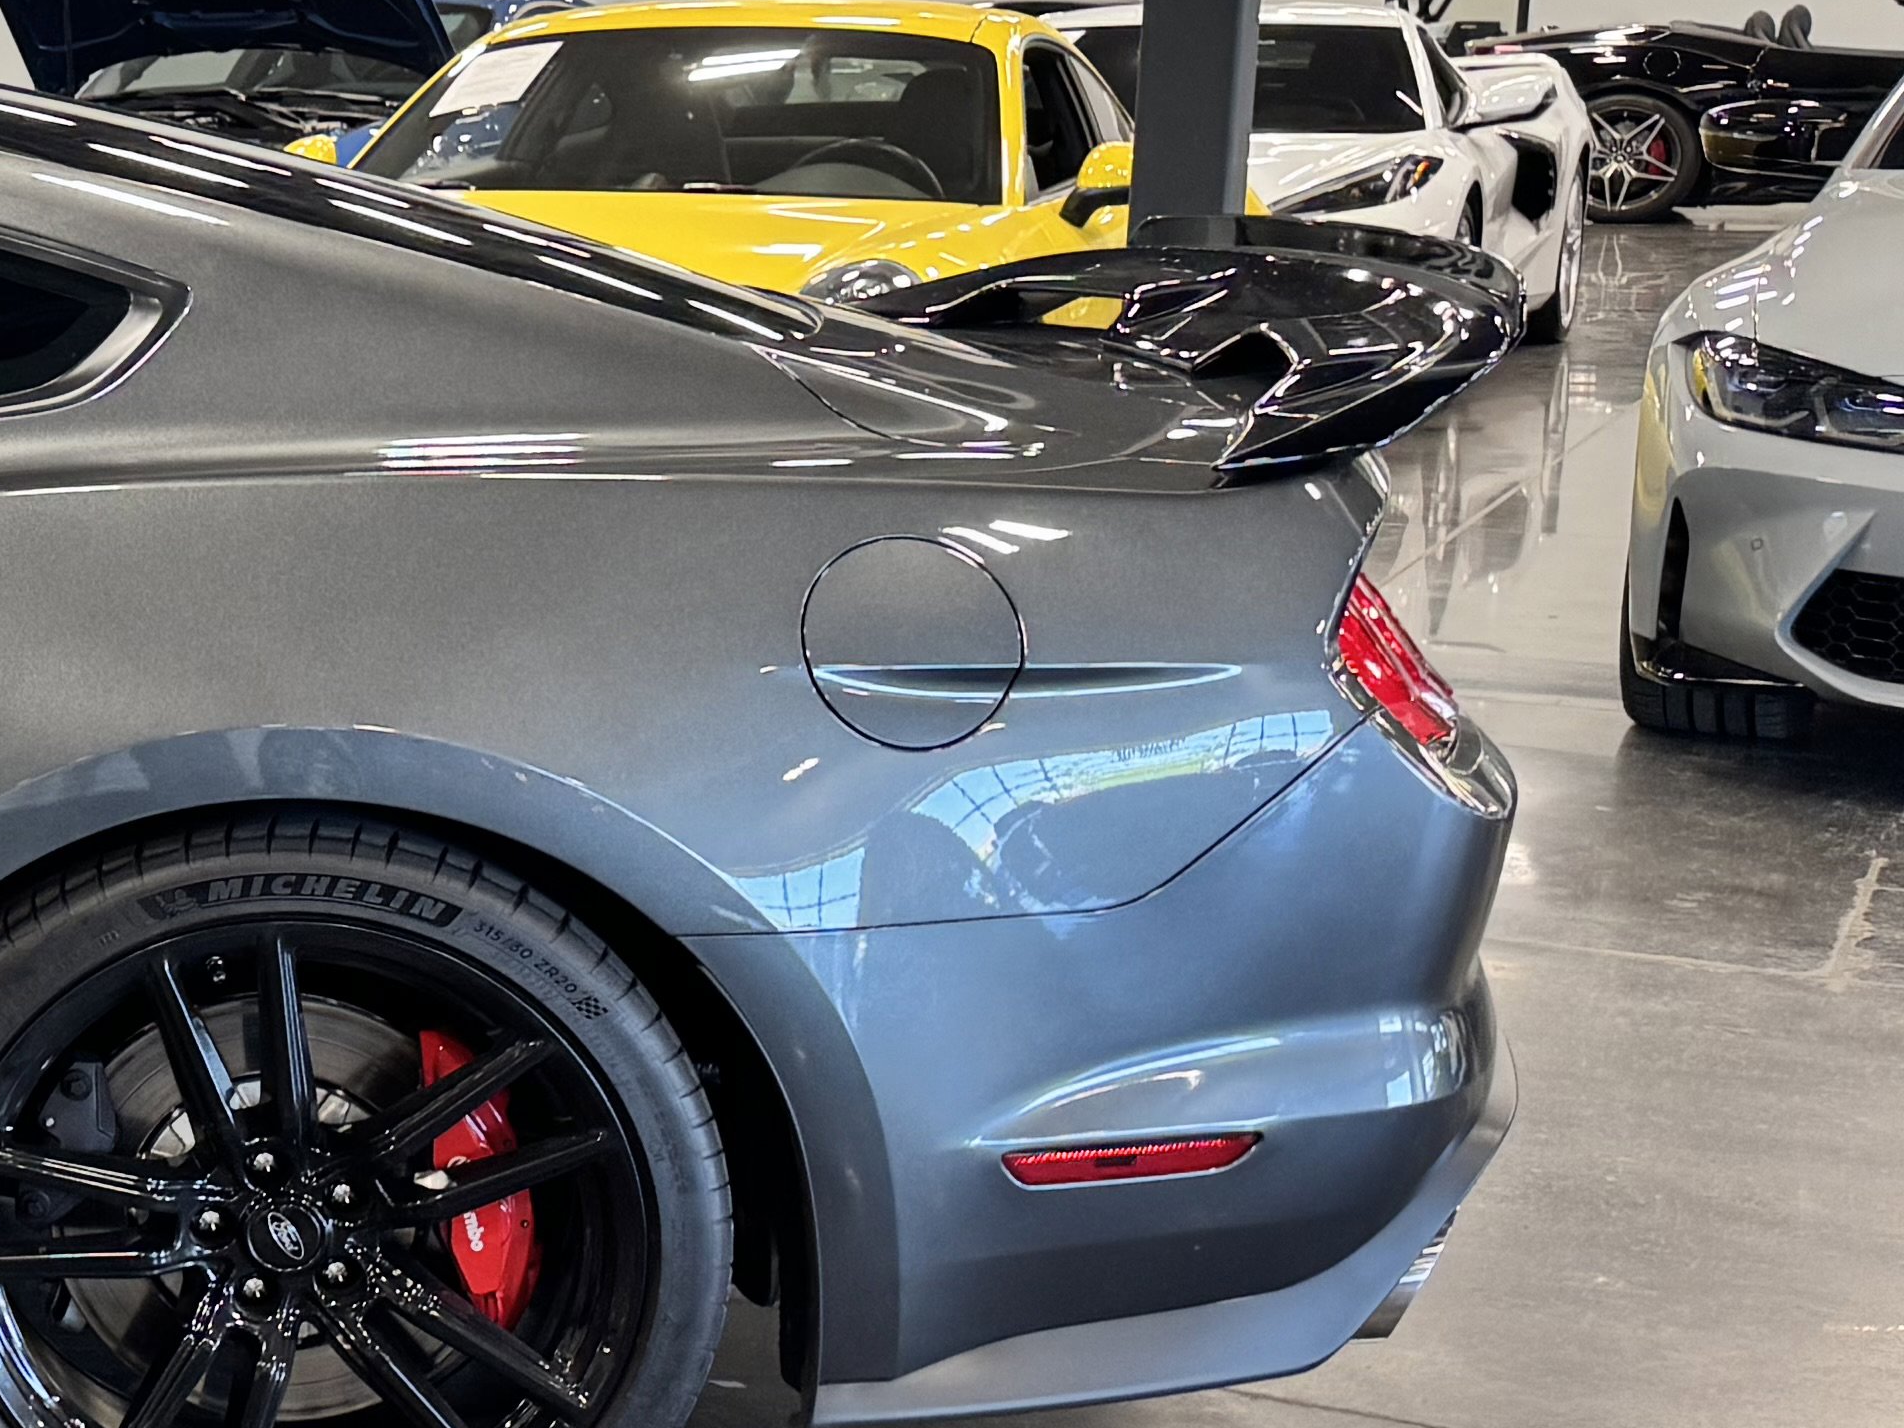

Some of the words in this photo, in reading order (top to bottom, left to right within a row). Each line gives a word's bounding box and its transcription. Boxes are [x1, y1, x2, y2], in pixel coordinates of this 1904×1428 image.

[207, 874, 446, 921] MICHELIN
[473, 920, 533, 960] 315/30
[533, 958, 578, 994] ZR20
